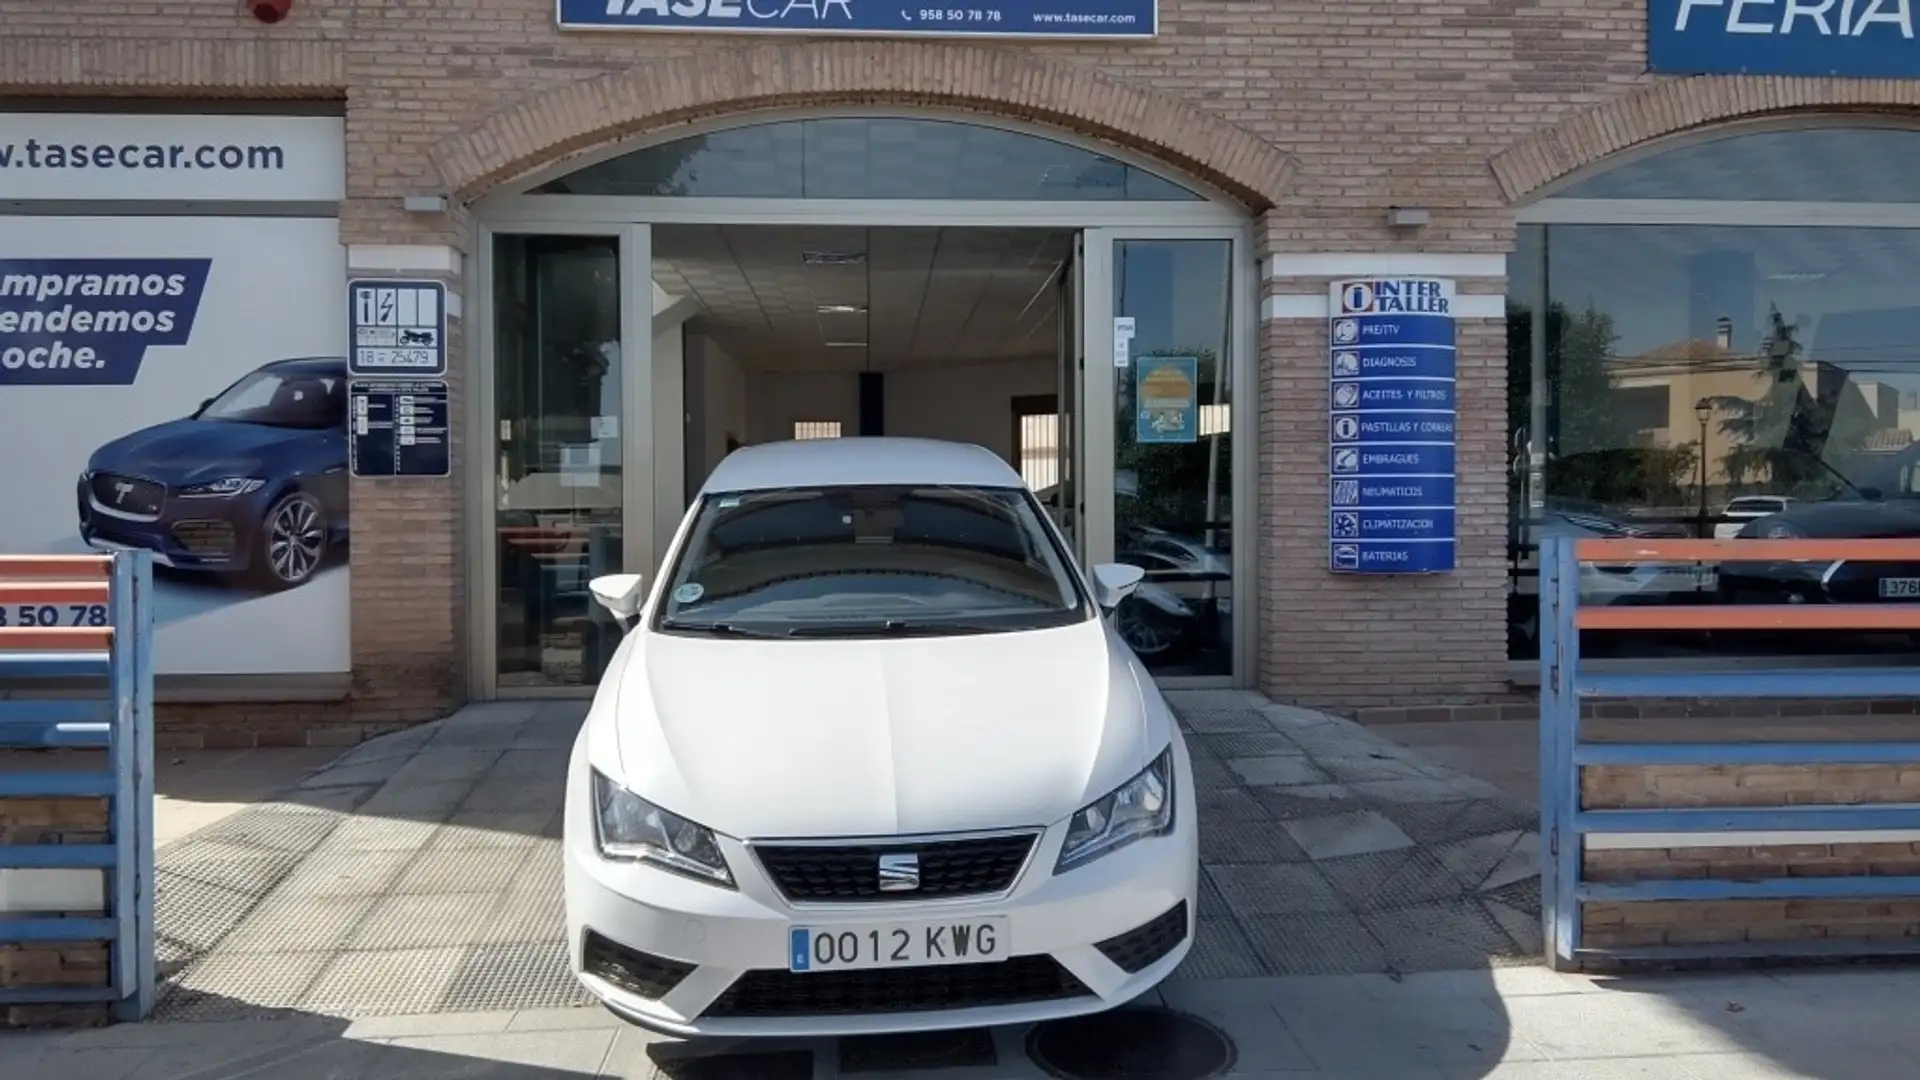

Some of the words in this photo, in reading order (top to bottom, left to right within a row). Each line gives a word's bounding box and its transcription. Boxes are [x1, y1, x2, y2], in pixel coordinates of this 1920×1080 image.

[920, 10, 943, 20] 958
[947, 10, 963, 20] 50
[968, 10, 982, 21] 78
[987, 11, 1001, 21] 78
[1033, 12, 1136, 23] www.tasecar.com
[1674, 0, 1914, 38] FERIA
[1375, 281, 1441, 297] INTER
[1376, 296, 1449, 313] TALLER
[2, 341, 105, 369] oche.
[1363, 357, 1417, 368] DIAGNOSIS
[1362, 389, 1403, 400] ACEITES
[1407, 389, 1413, 400] Y
[1361, 421, 1411, 432] PASTILLAS
[1413, 422, 1419, 432] Y
[1363, 454, 1420, 464] EMBRAGUES
[1362, 486, 1423, 497] NEUMATICOS
[1363, 519, 1434, 529] CLIMATIZACION
[1362, 551, 1409, 562] BATERIAS
[1890, 579, 1920, 594] 376
[18, 605, 59, 627] 50
[69, 605, 107, 627] 78
[814, 928, 910, 964] 0012
[926, 924, 996, 959] KWG
